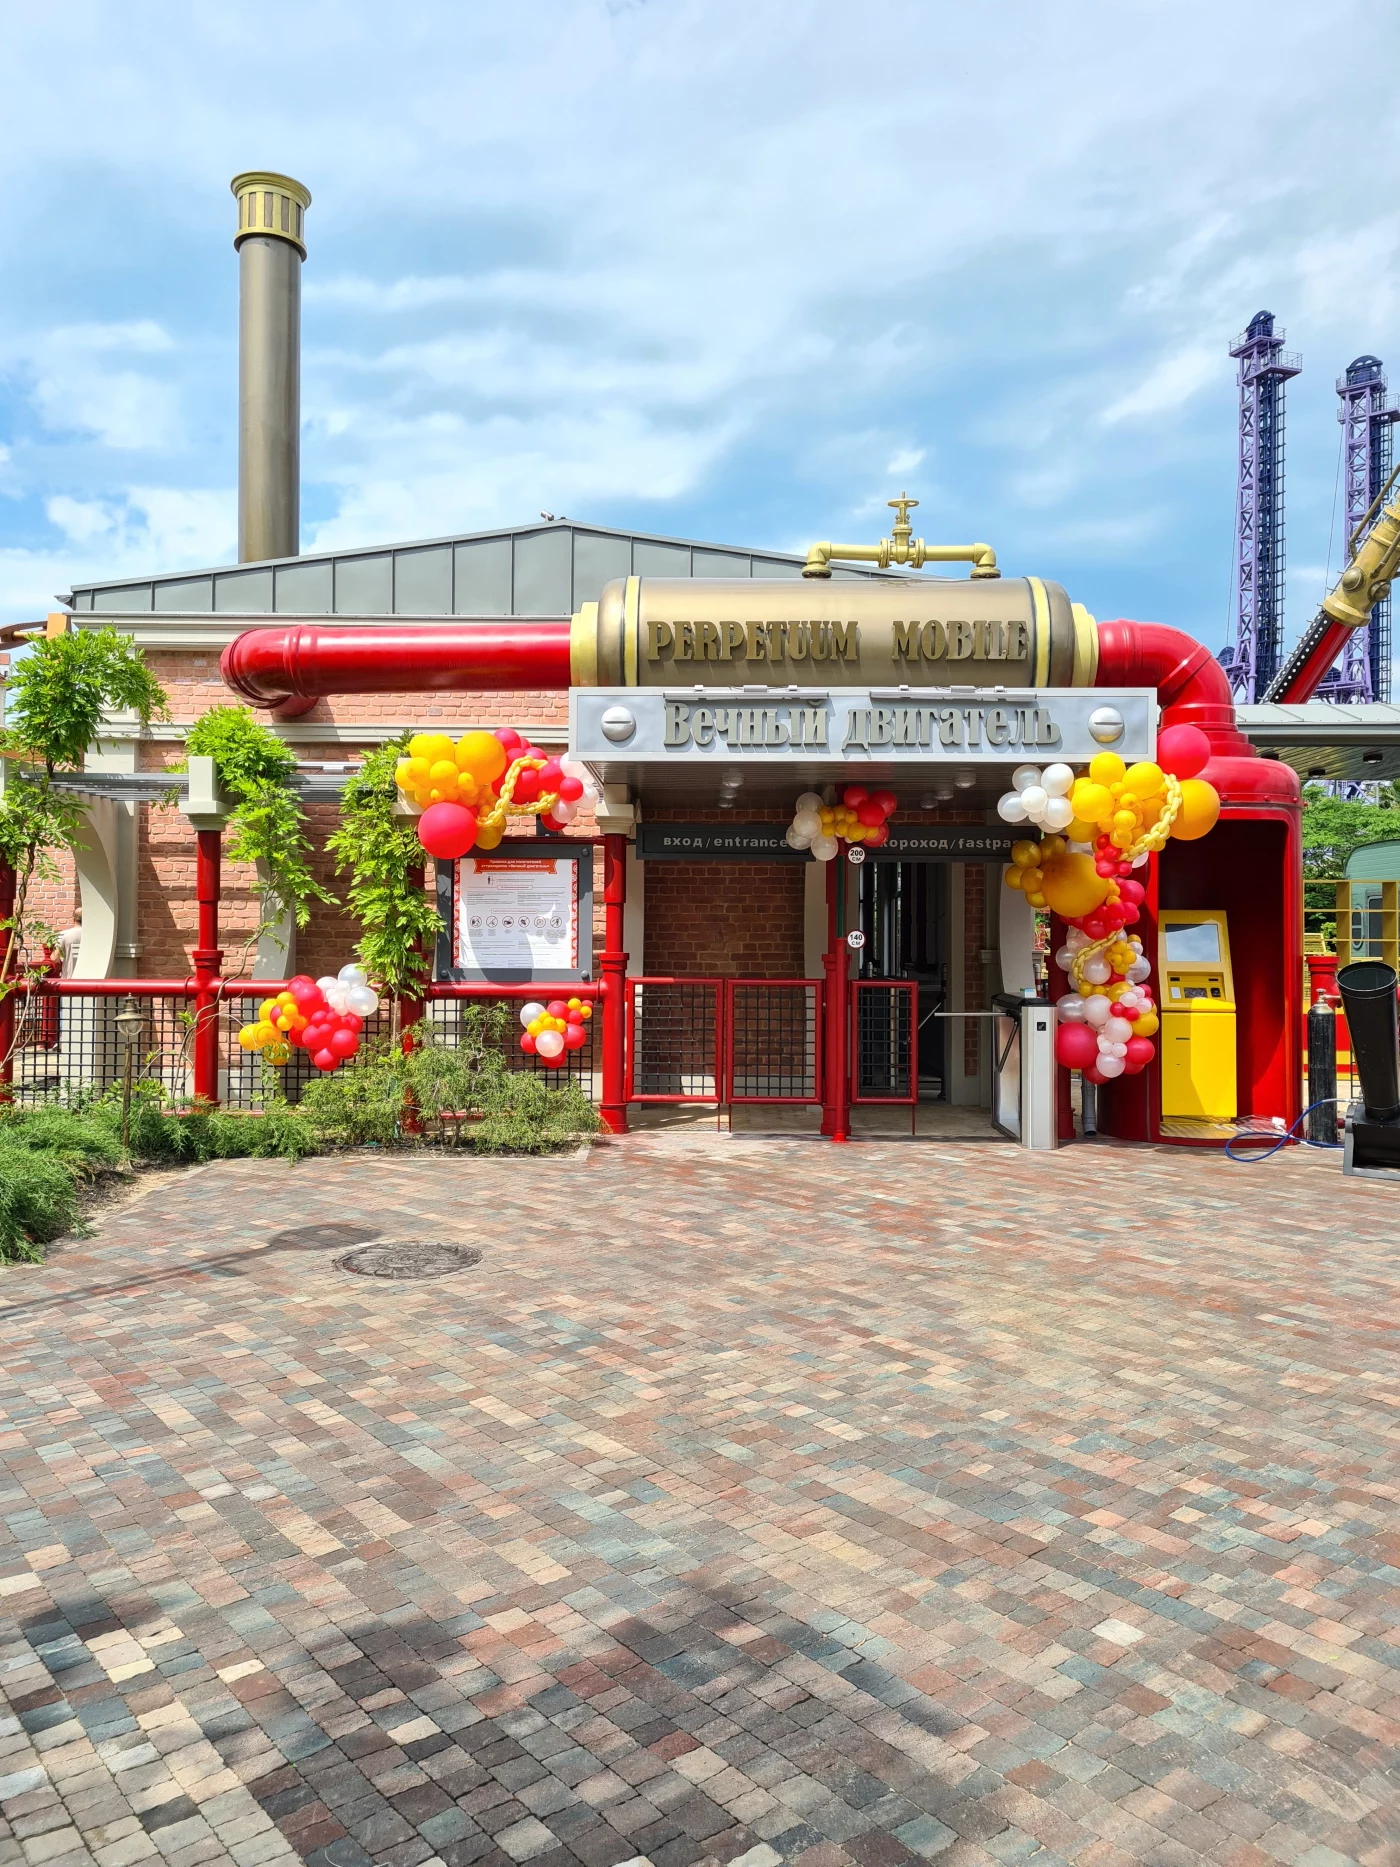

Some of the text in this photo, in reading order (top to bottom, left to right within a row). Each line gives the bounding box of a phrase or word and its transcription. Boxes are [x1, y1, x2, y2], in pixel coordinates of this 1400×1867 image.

[647, 620, 1028, 661] PERPETUUM MOBILE
[664, 700, 1061, 750] Вечный двигатель
[663, 836, 788, 849] вход/entrance
